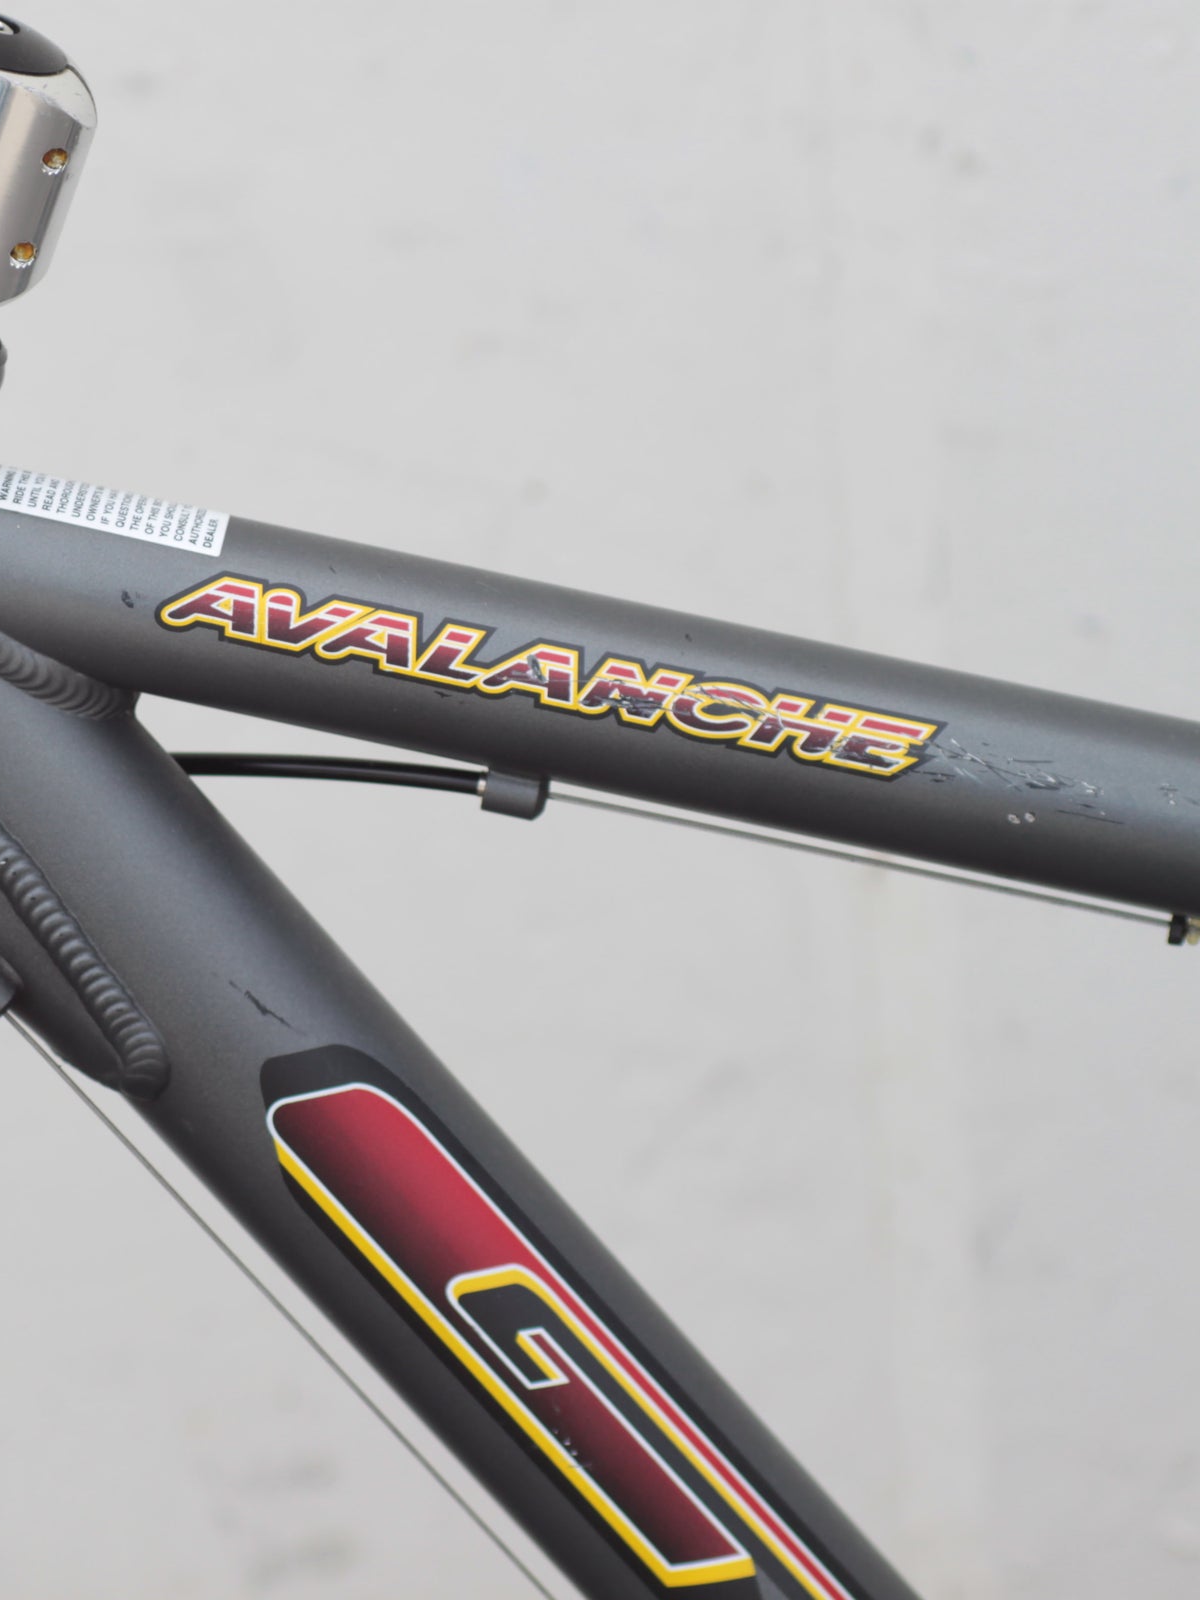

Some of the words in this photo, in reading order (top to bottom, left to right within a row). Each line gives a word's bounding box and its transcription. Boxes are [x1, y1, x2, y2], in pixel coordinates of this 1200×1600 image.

[13, 486, 26, 505] RIDE
[28, 487, 42, 508] UNTIL
[42, 490, 57, 511] READ
[159, 521, 172, 537] YOU
[160, 575, 940, 777] AVALANCHE
